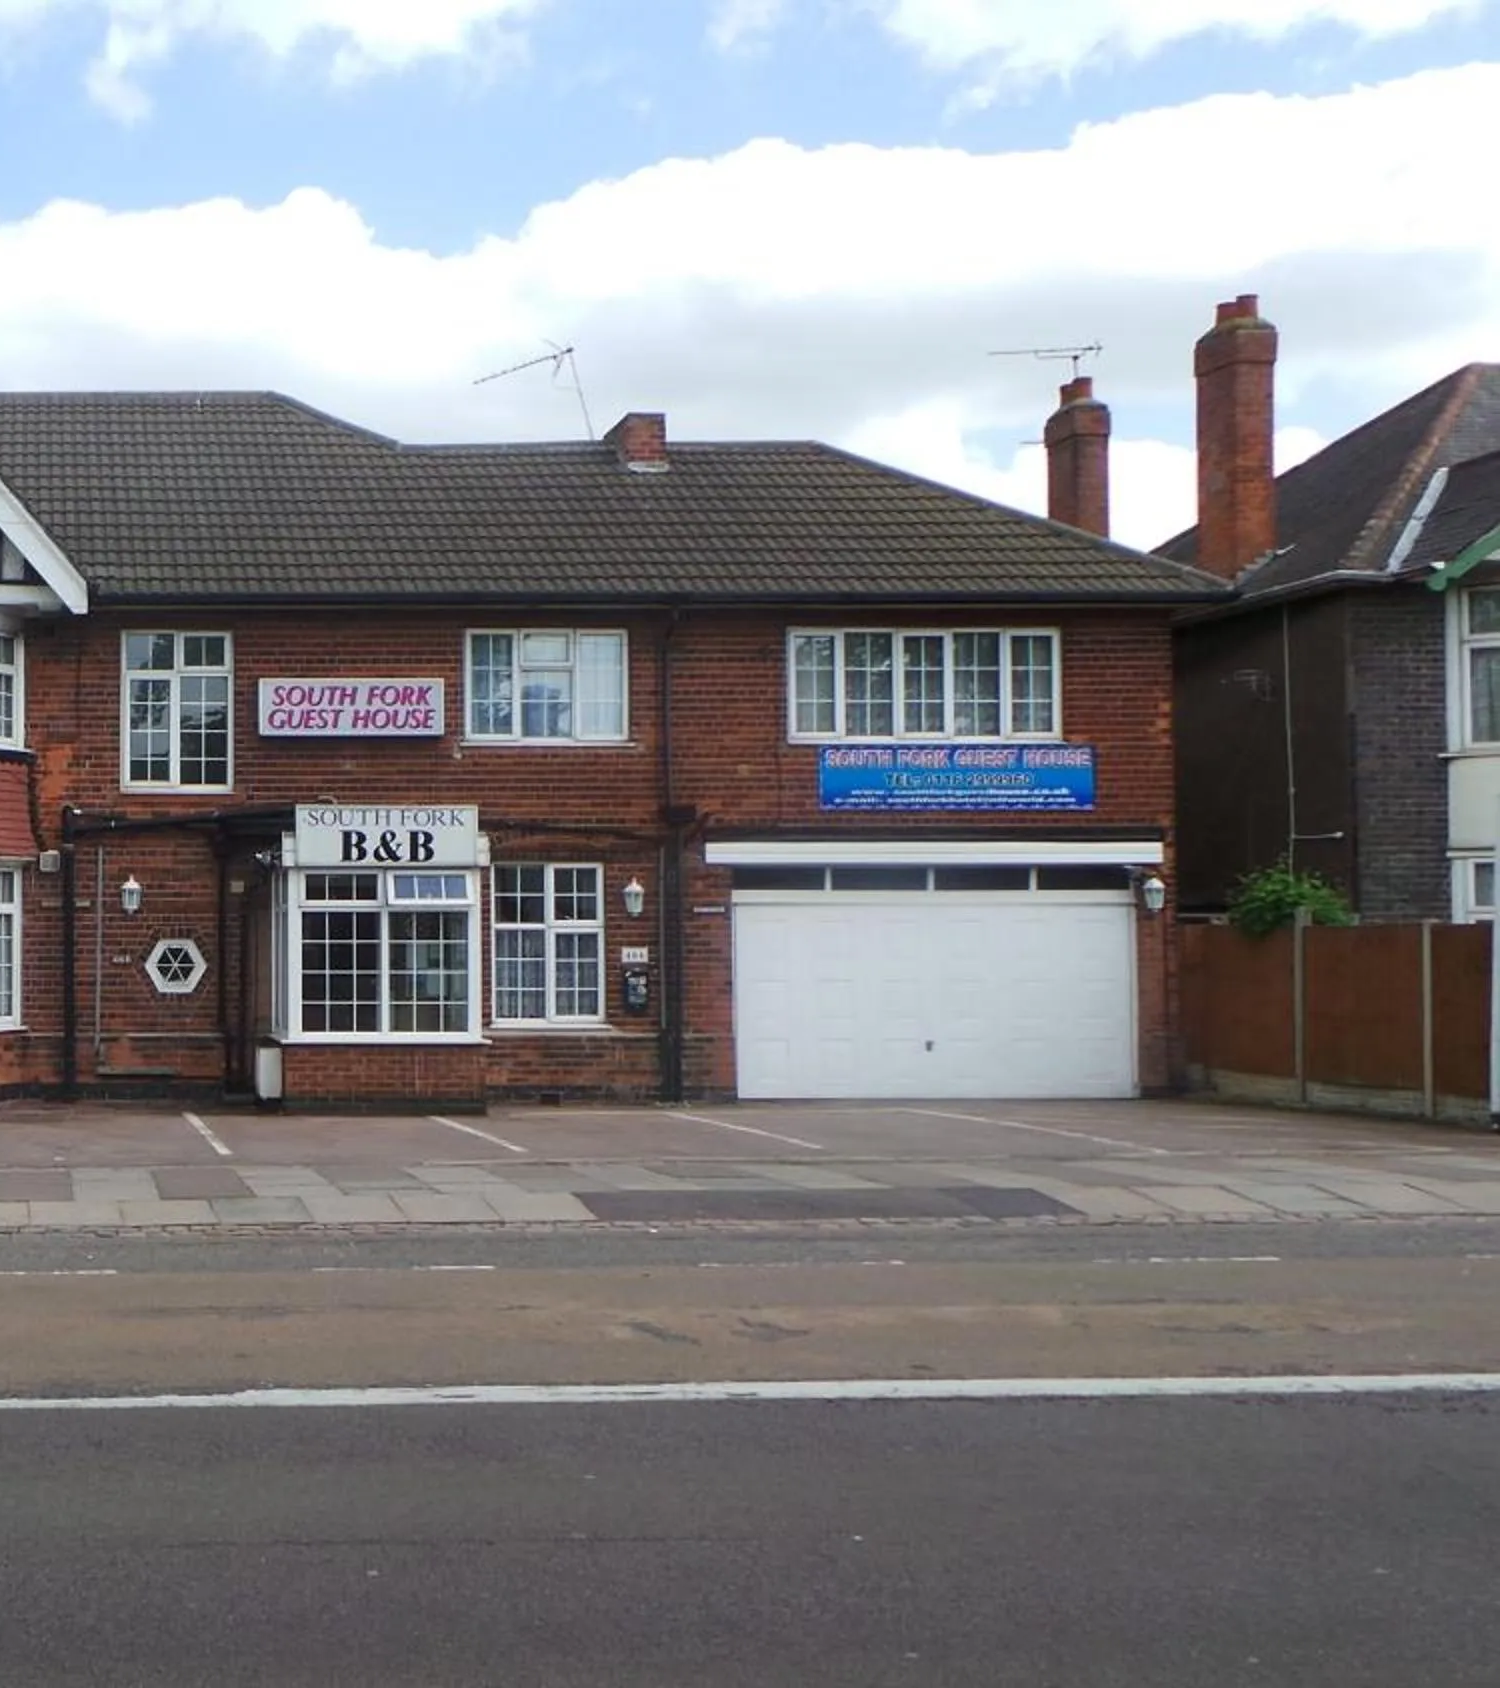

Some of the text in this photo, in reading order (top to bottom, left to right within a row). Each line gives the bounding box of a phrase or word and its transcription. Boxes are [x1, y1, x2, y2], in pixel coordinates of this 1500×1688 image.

[271, 685, 433, 707] SOUTH FORK
[267, 709, 436, 729] GUEST HOUSE
[825, 748, 1092, 768] SOUTH FORK GUEST HOUSE
[307, 807, 465, 826] SOUTH FORK
[340, 829, 435, 863] B&B
